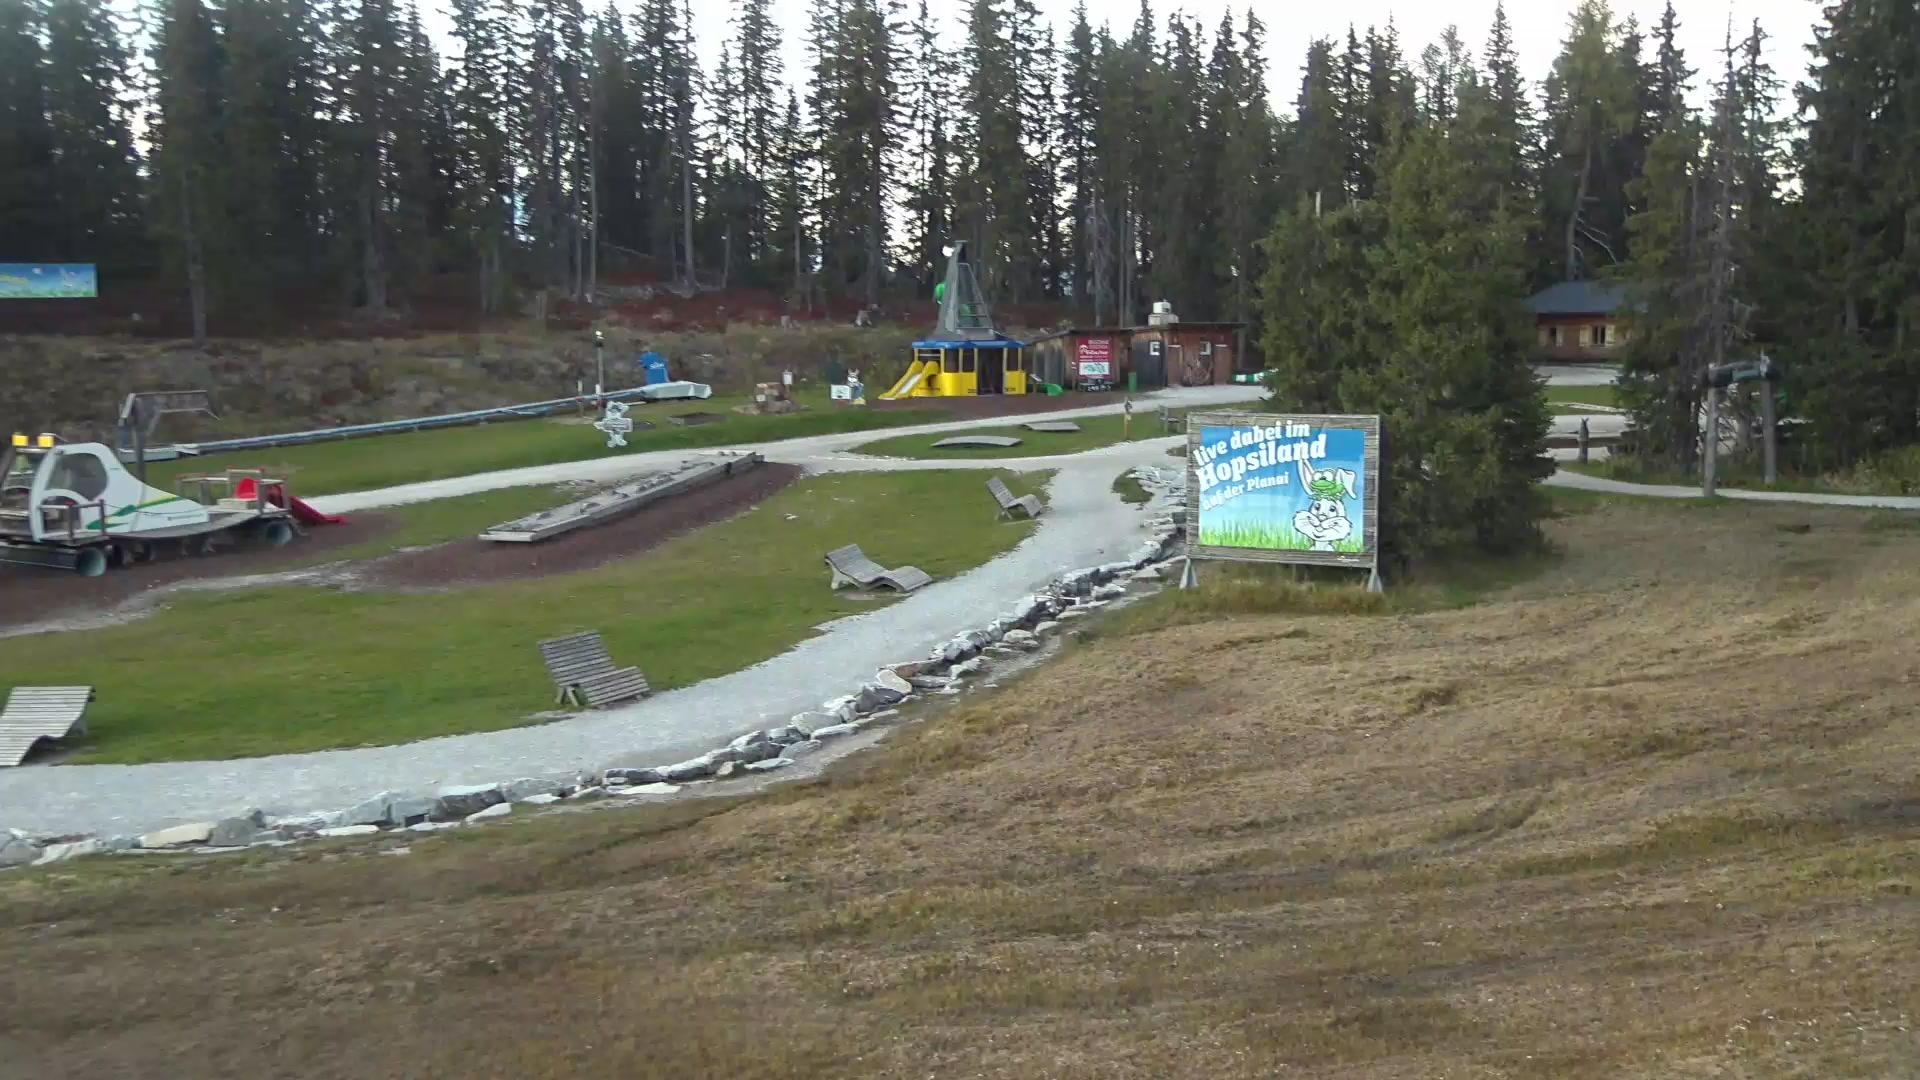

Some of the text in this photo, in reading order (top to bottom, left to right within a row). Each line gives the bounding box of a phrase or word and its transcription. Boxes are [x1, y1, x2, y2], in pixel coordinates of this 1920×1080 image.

[1193, 419, 1310, 466] live dabei im
[1195, 433, 1327, 492] Hopsiland
[1223, 484, 1245, 500] der
[1245, 471, 1289, 491] Planai
